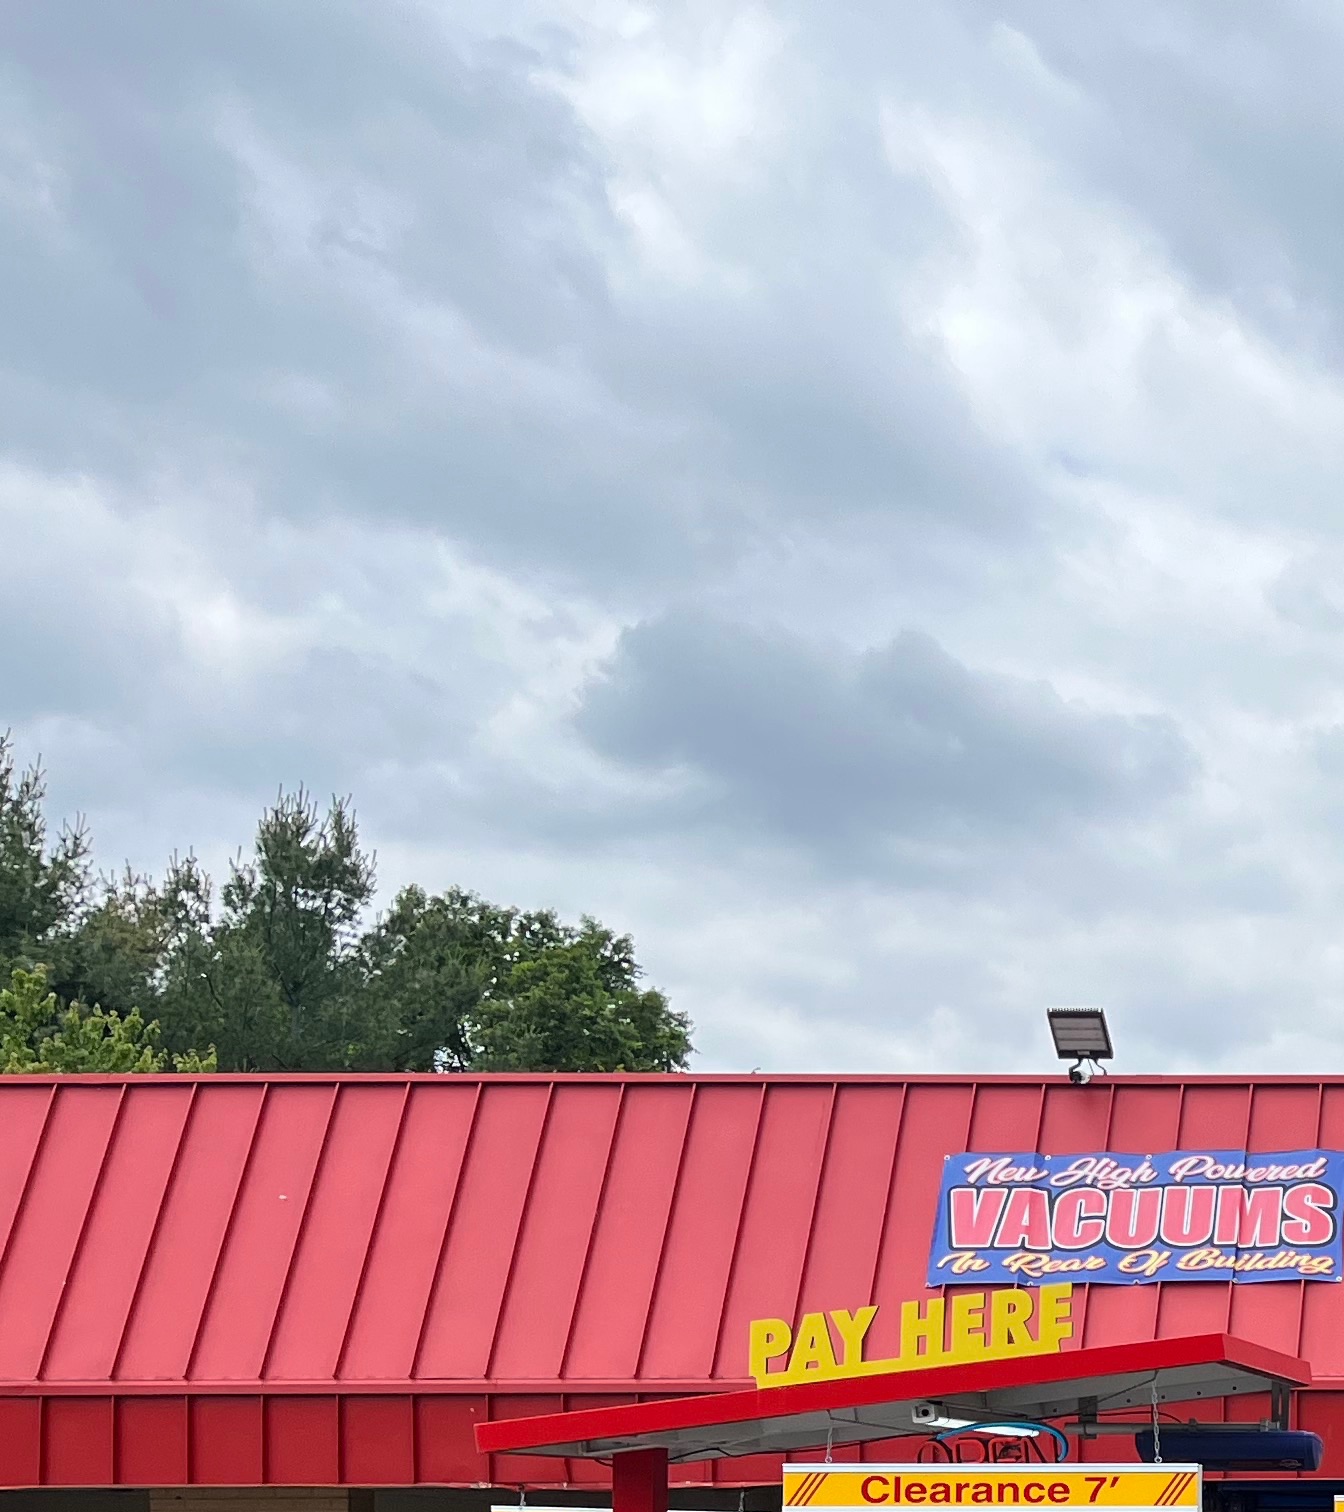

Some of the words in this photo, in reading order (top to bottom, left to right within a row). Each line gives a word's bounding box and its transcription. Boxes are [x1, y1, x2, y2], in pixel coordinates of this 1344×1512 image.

[964, 1157, 1049, 1184] New
[1049, 1157, 1158, 1190] High
[1169, 1155, 1327, 1184] Powered
[949, 1184, 1336, 1250] VACUUMS
[937, 1250, 990, 1274] In
[1003, 1251, 1107, 1277] Rear
[1118, 1249, 1169, 1274] Of
[1177, 1248, 1336, 1274] Building
[749, 1305, 879, 1380] PAY
[900, 1282, 1073, 1356] HERE
[860, 1475, 1070, 1504] Clearance
[1084, 1476, 1120, 1503] 7'
